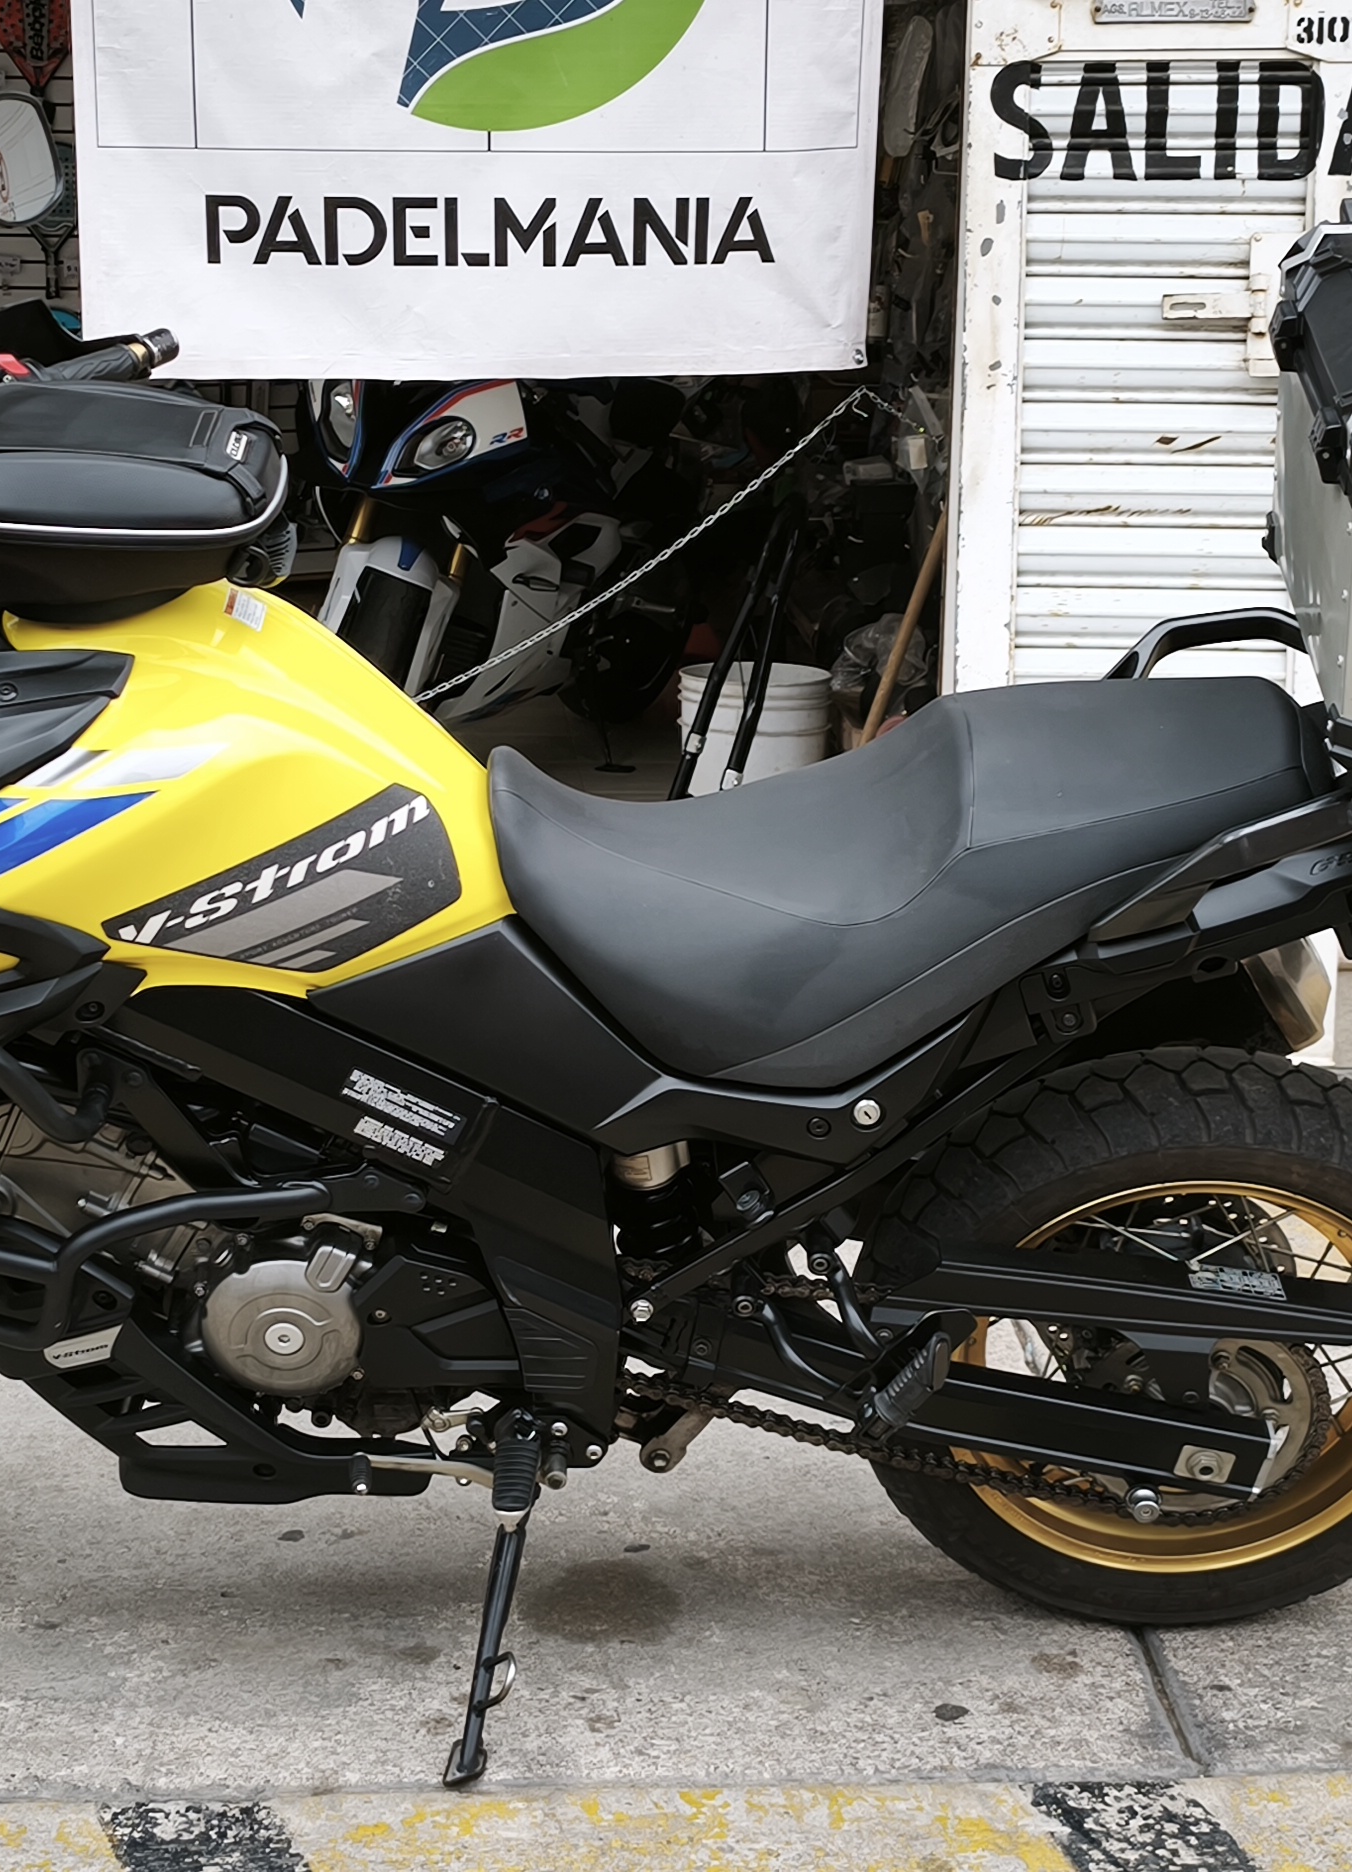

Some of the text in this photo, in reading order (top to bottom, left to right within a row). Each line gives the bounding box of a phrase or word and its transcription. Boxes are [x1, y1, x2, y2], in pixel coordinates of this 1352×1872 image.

[204, 194, 776, 269] PADELMANIA
[489, 426, 524, 446] RR
[119, 793, 431, 946] V-Strom
